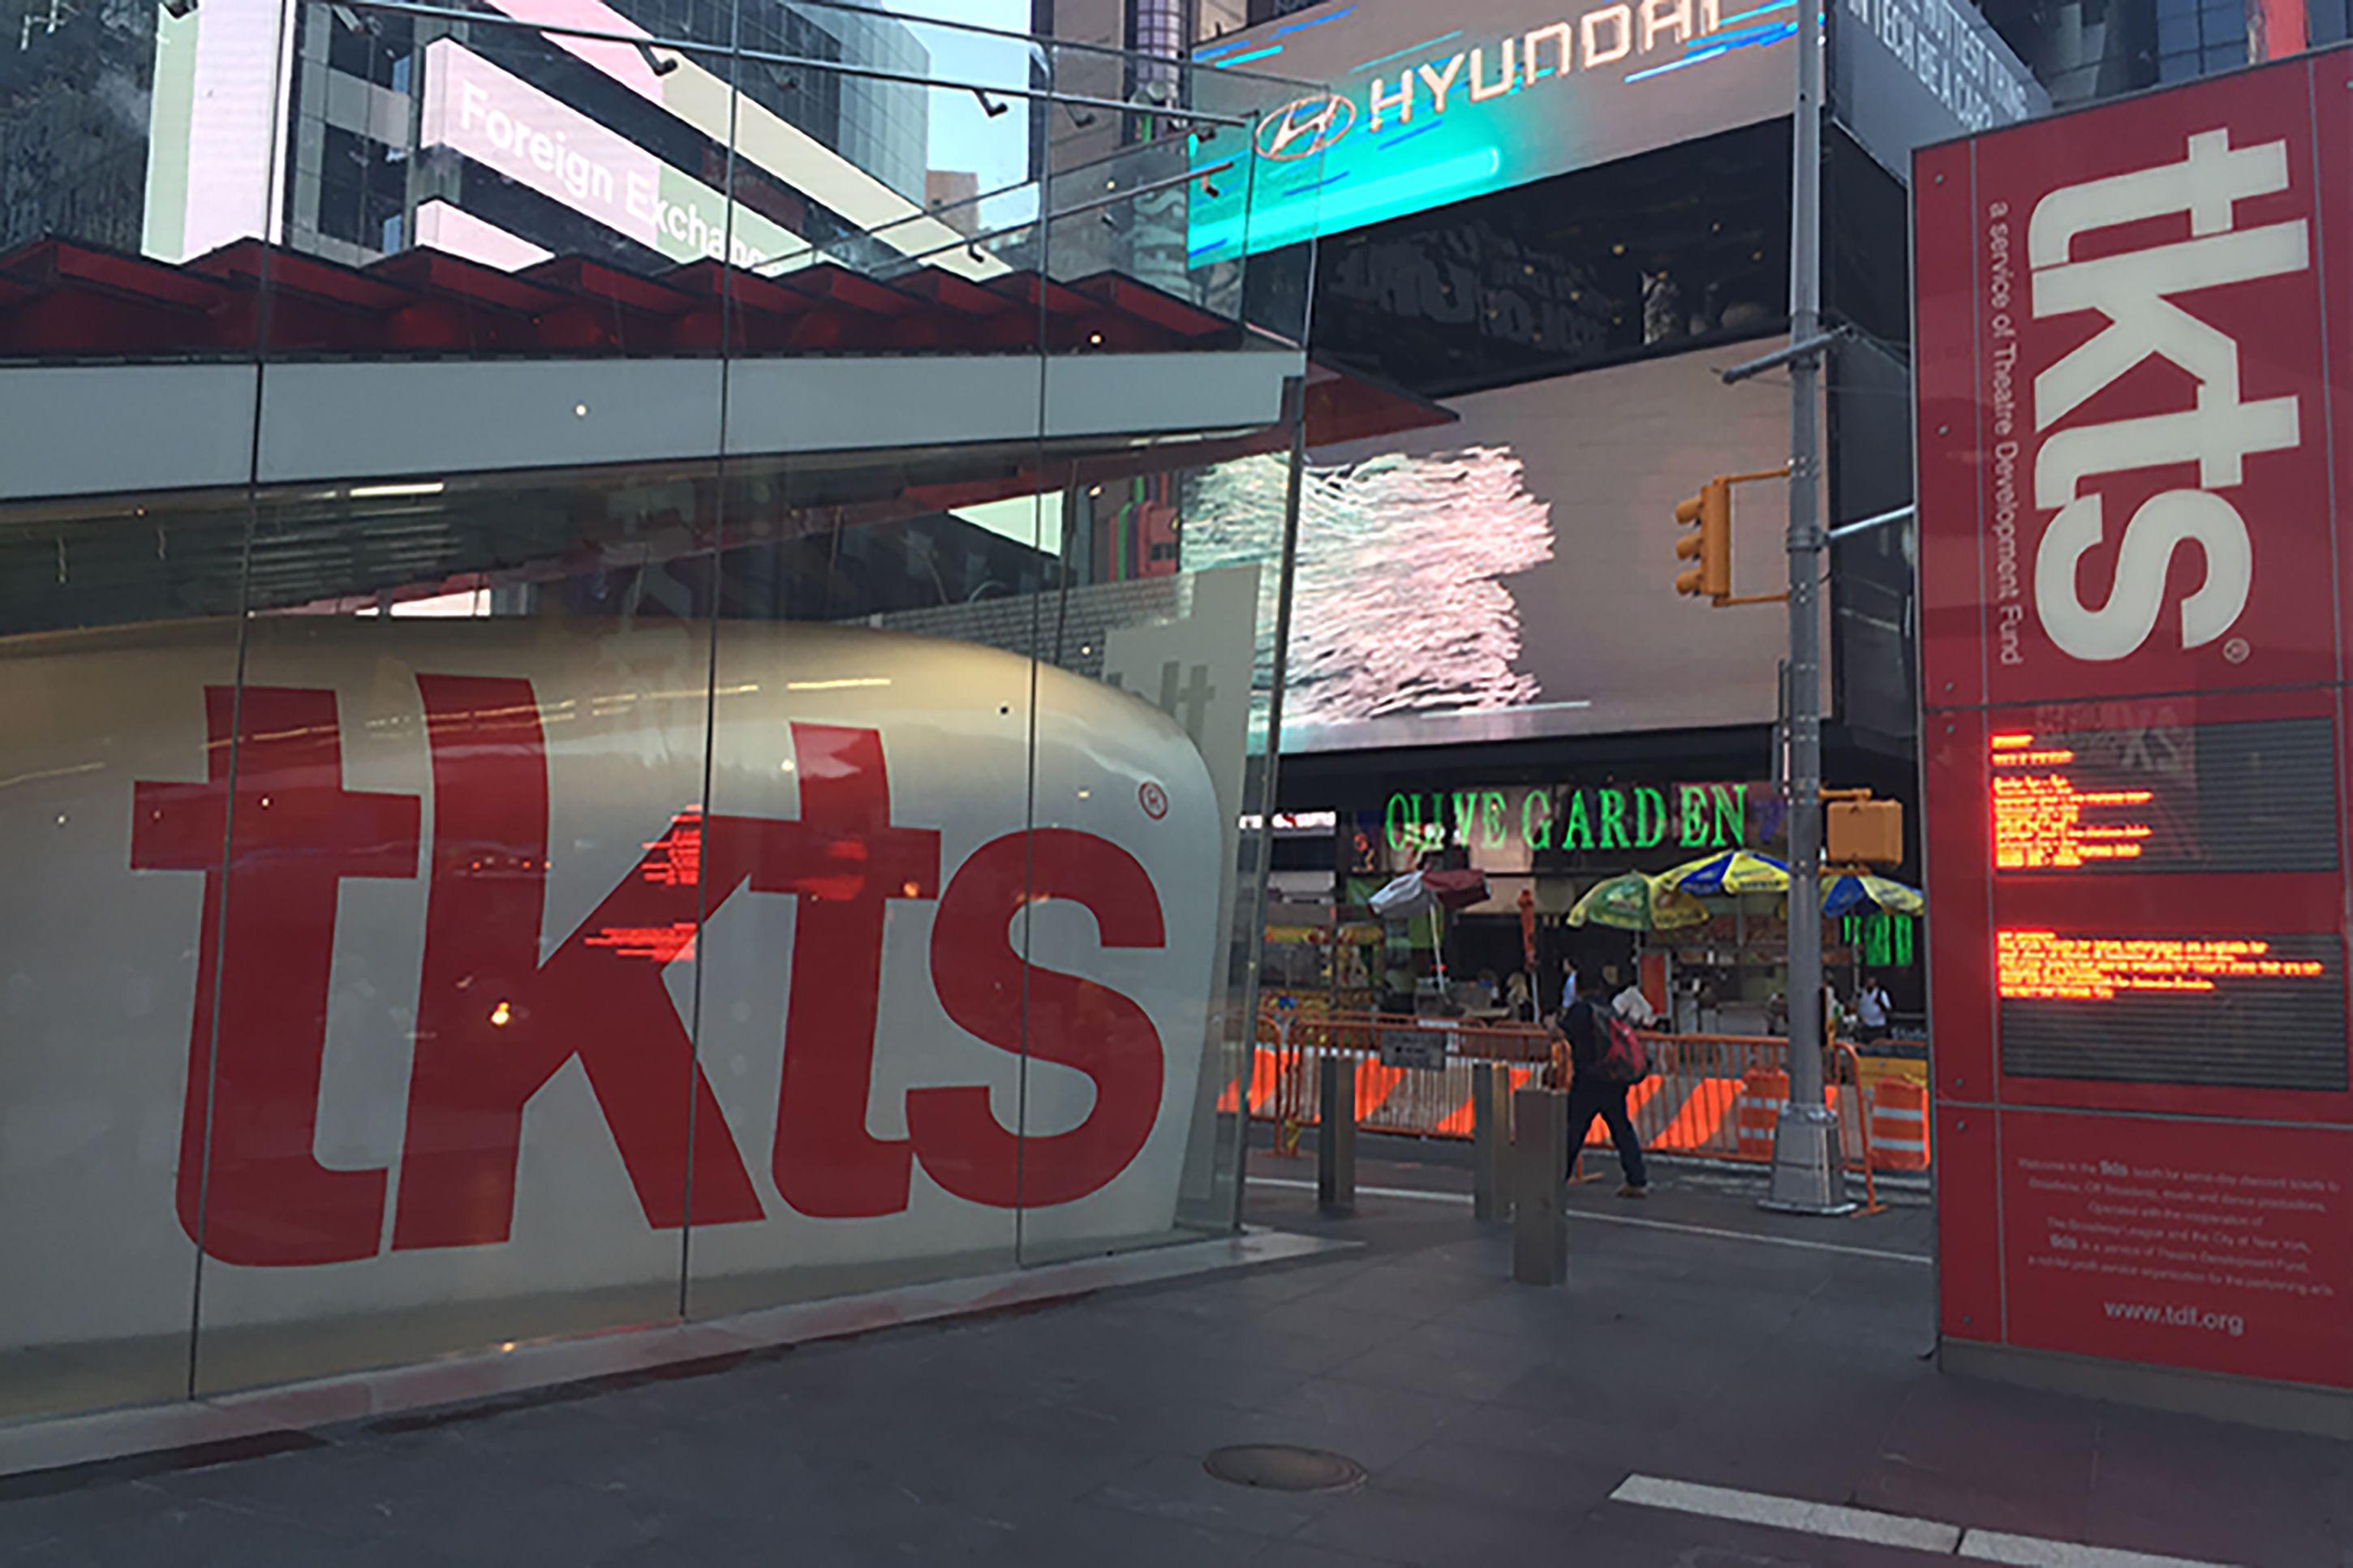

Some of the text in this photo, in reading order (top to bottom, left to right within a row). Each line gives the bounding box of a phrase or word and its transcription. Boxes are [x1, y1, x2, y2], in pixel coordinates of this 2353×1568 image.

[1369, 0, 1721, 131] HYUNDAI
[459, 79, 775, 274] Foreign Exchan
[1990, 201, 2024, 665] a service of Theatre Development Fund
[2028, 127, 2310, 662] tkts
[1385, 783, 1748, 851] OLIVE GARDEN
[129, 672, 1167, 1267] tkts
[2102, 1300, 2244, 1338] www.tdf.org
